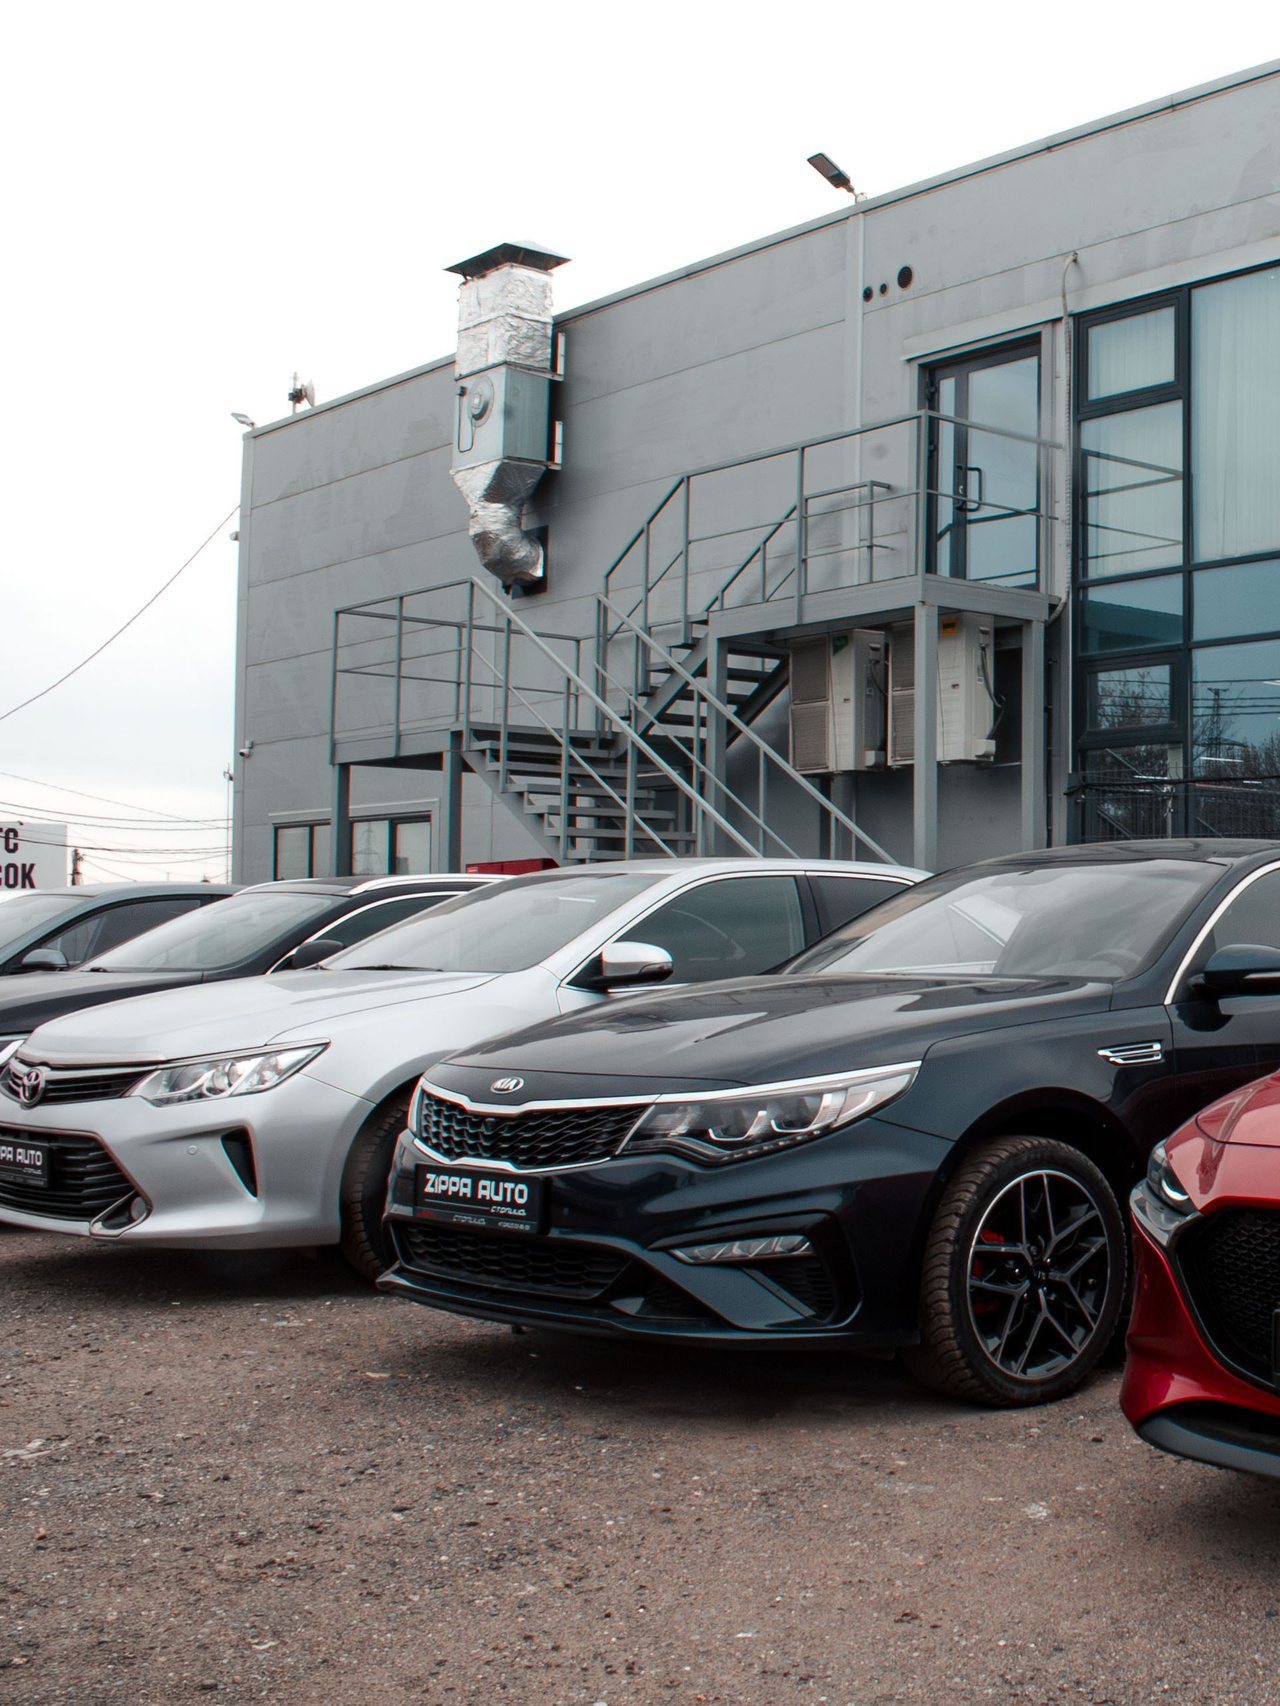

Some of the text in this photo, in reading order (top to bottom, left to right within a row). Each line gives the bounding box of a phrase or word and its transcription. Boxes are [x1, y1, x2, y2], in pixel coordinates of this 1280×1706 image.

[0, 1145, 43, 1166] PA AUTO
[424, 1173, 529, 1204] ZIPPA AUTO
